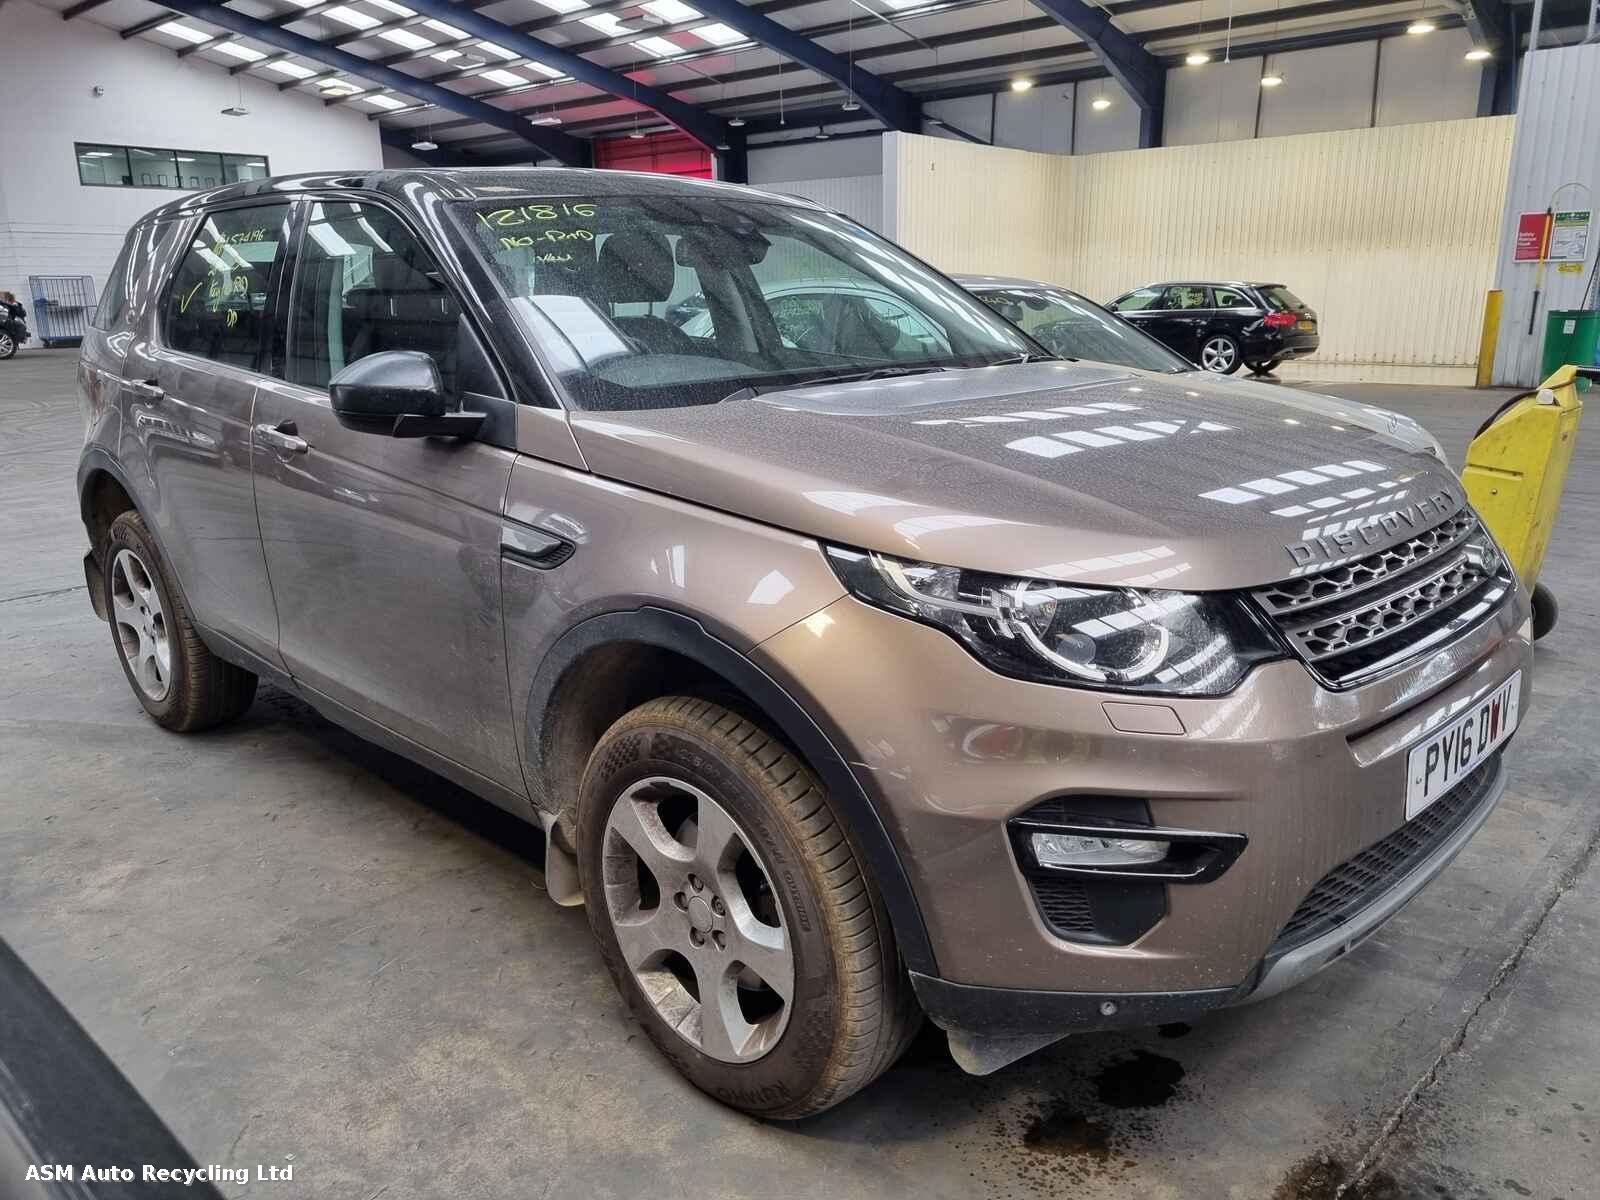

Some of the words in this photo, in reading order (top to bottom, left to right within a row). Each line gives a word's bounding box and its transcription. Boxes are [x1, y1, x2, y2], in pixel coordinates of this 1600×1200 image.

[1284, 487, 1457, 567] DISCOVERY
[1423, 717, 1474, 797] PY16
[1477, 684, 1512, 755] DWV
